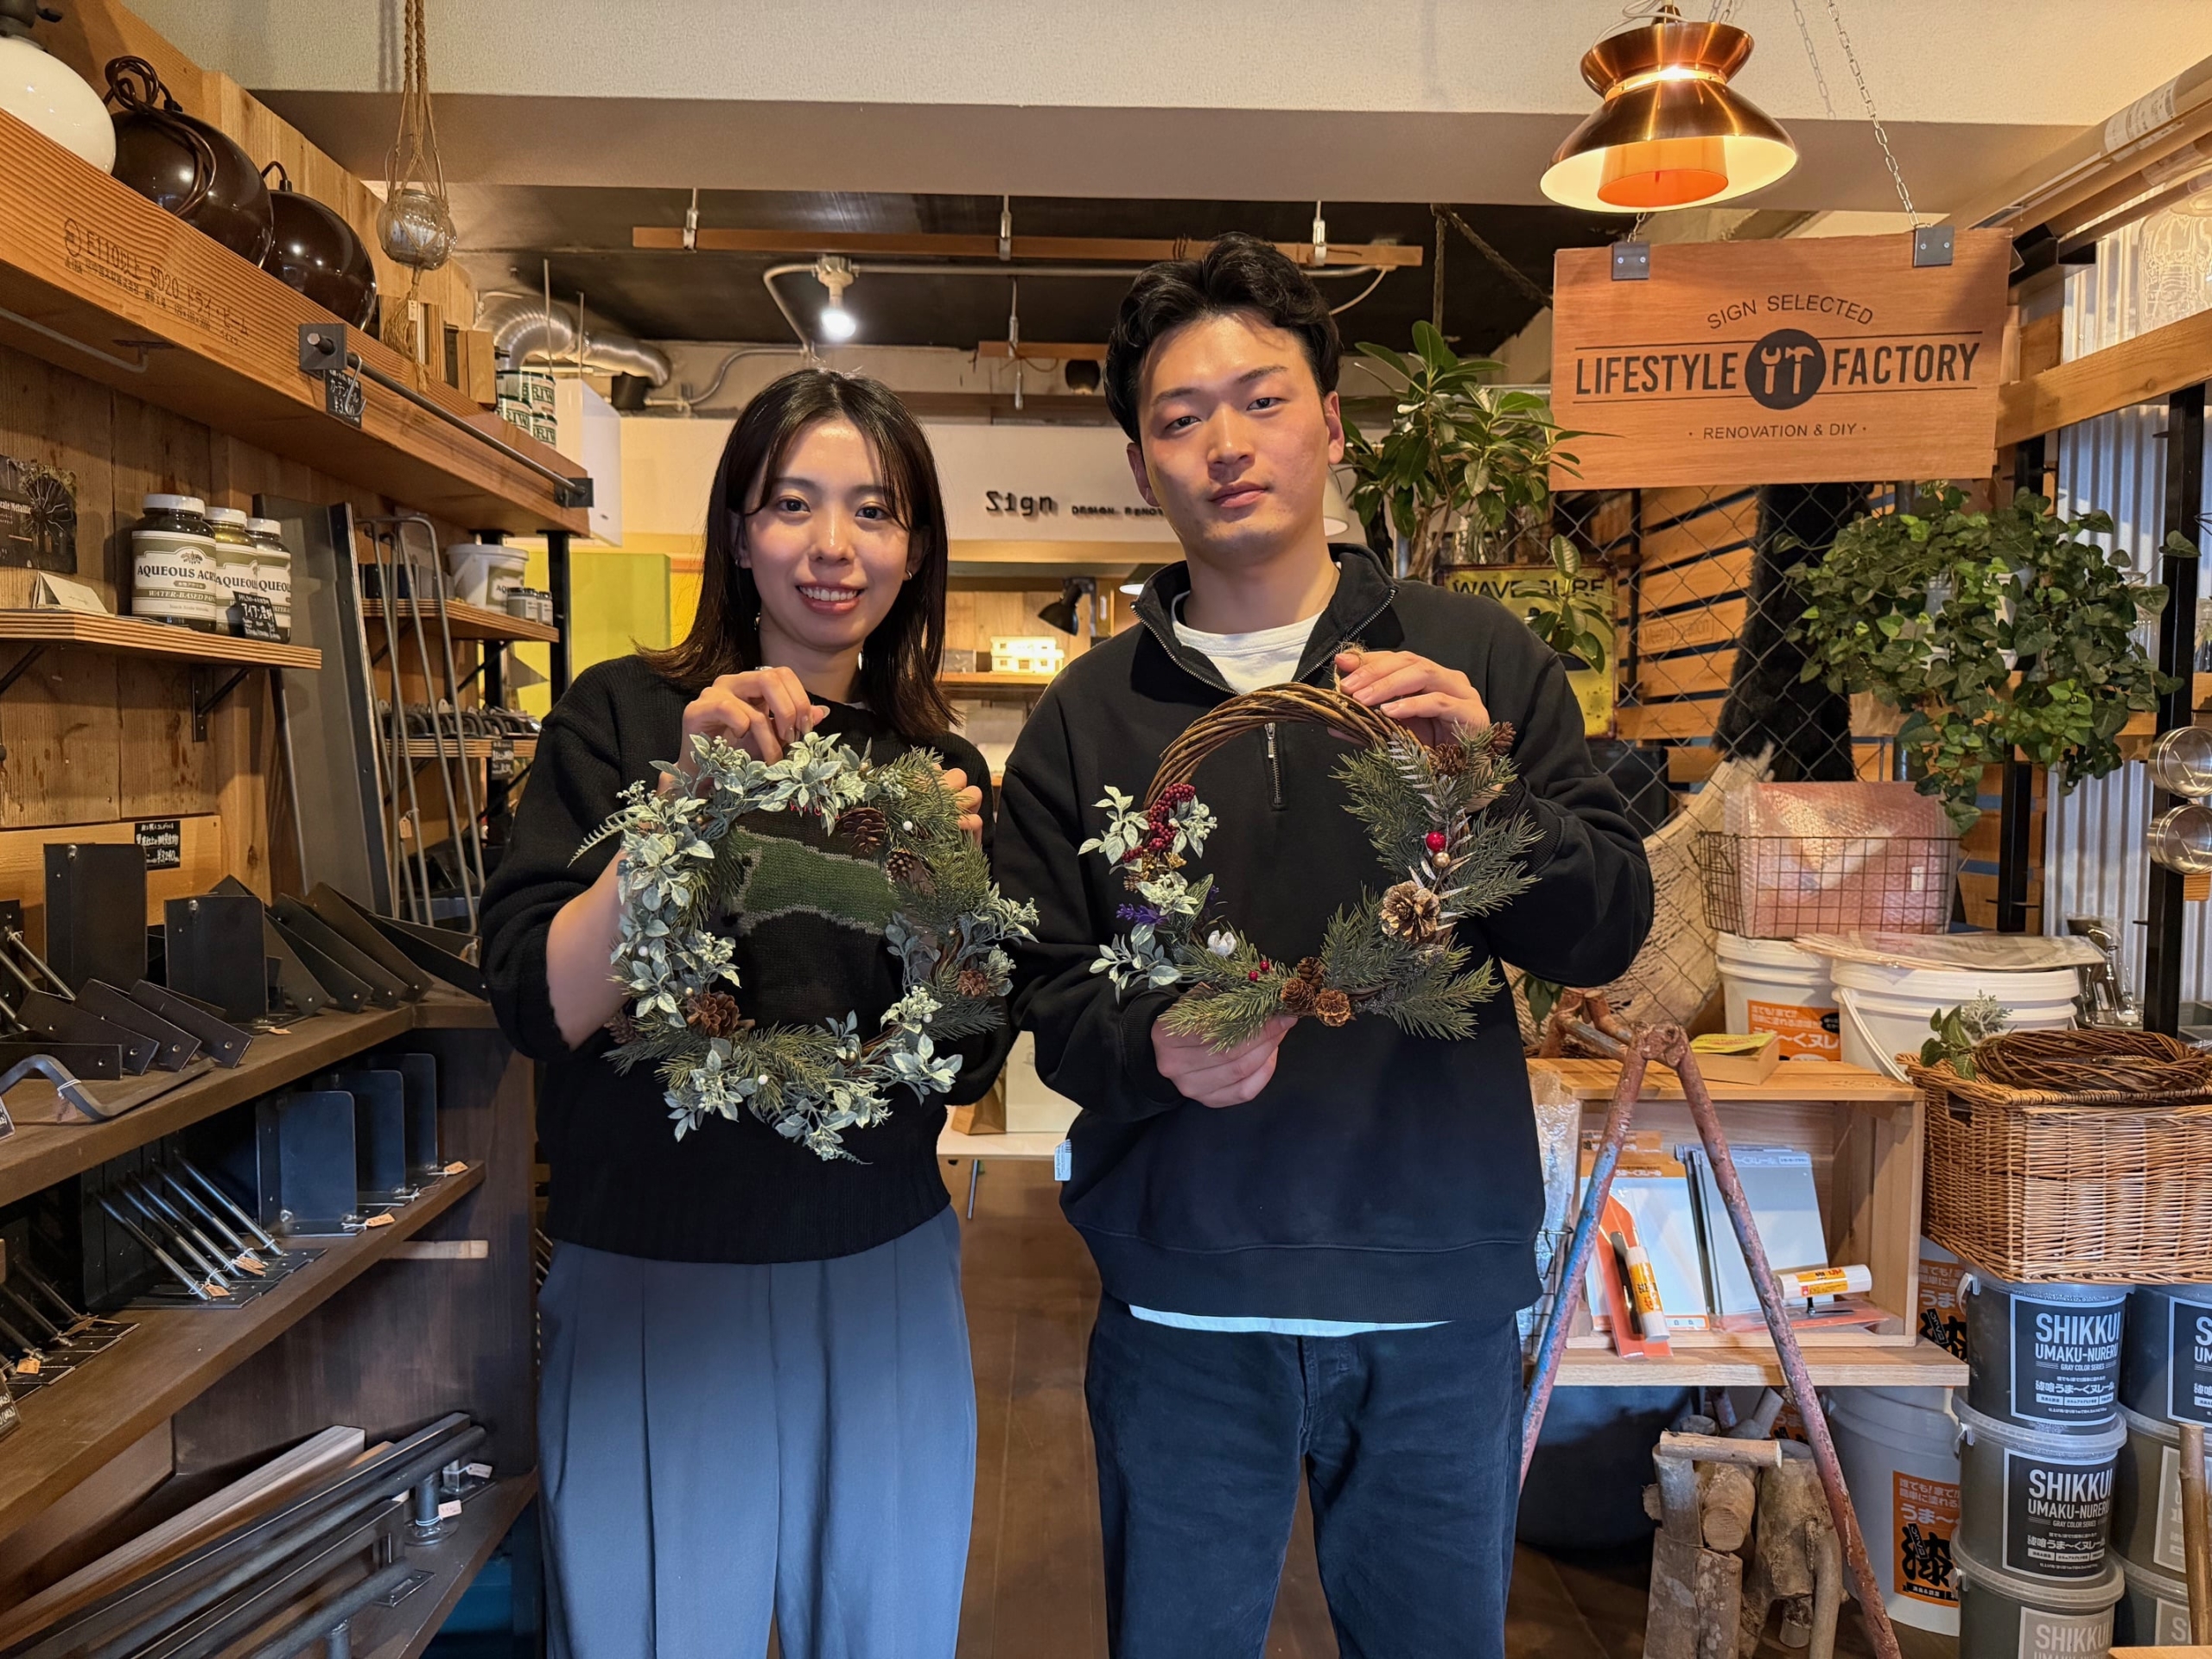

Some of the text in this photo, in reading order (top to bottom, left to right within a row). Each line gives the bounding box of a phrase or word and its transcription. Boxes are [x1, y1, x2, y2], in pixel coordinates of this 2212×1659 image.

[1707, 295, 1873, 329] SIGN SELECTED
[1576, 343, 1980, 394] LIFESTYLE FACTORY
[1703, 423, 1857, 439] RENOVATION & DIY
[137, 565, 195, 578] AQUEOUS
[149, 590, 203, 601] WATER-BASED
[2035, 1312, 2121, 1345] SHIKKUI
[2061, 1363, 2074, 1371] GRAY
[2091, 1363, 2105, 1371] SERIES
[2029, 1469, 2113, 1502] SHIKKUI
[2067, 1520, 2082, 1529] COLOR
[2035, 1622, 2109, 1652] SHIKKUI
